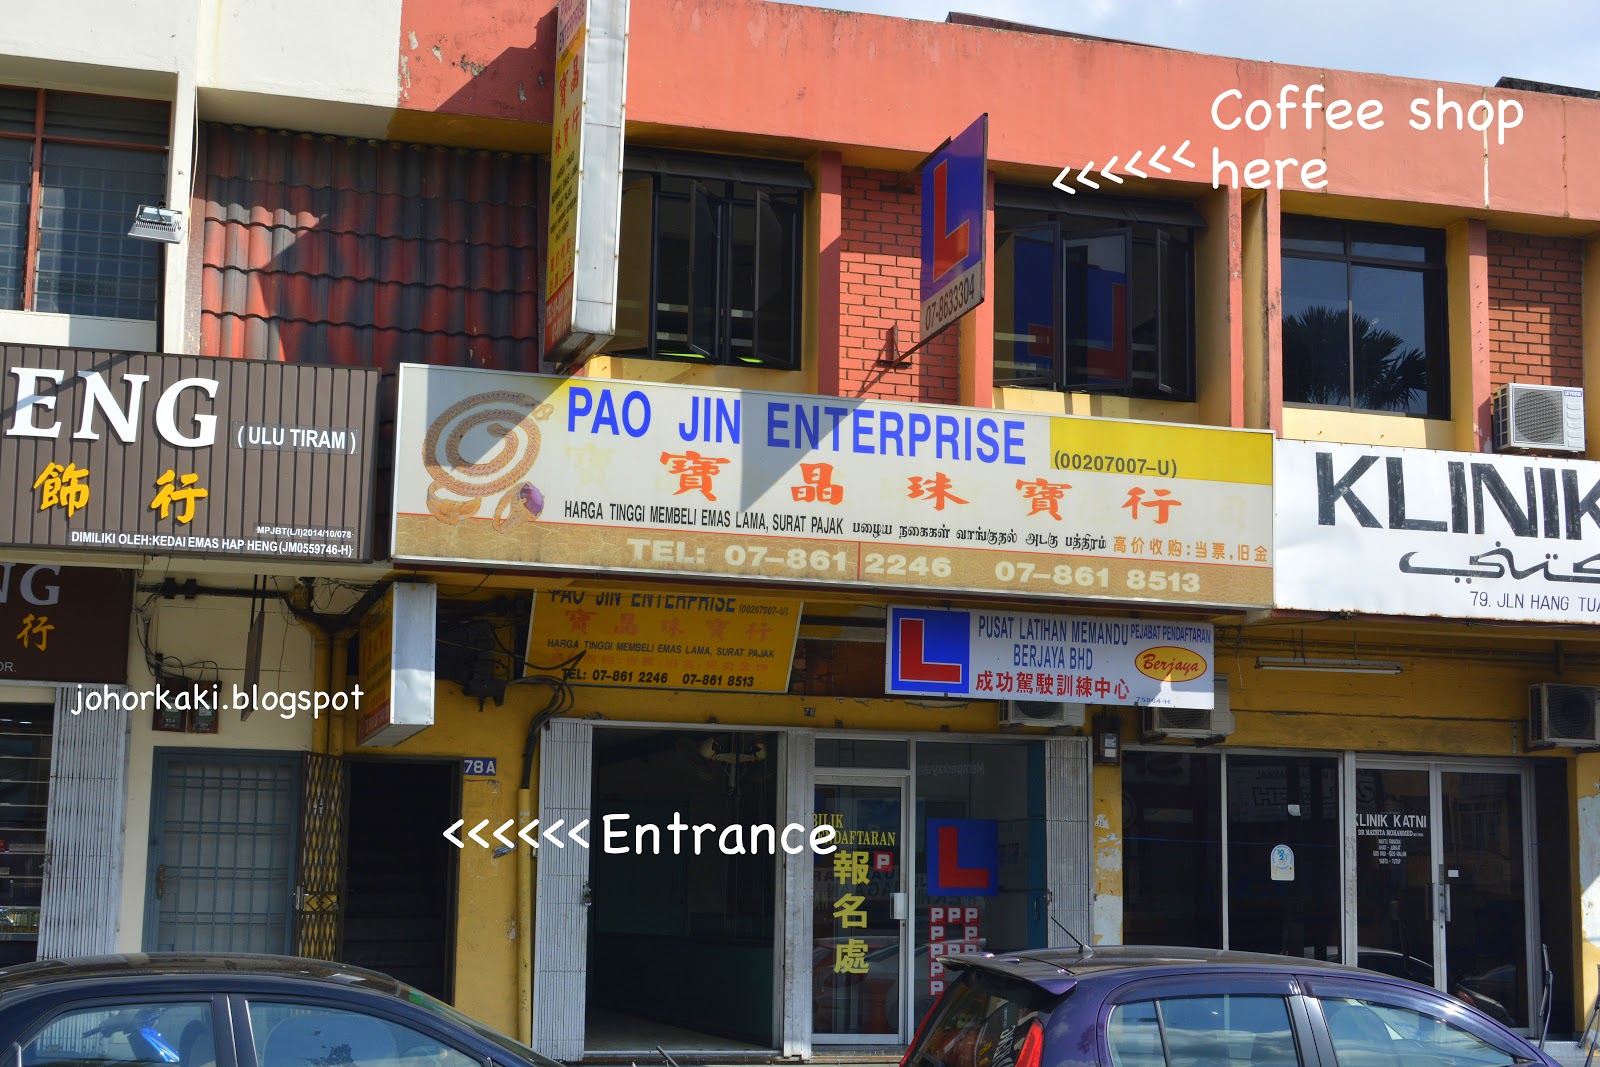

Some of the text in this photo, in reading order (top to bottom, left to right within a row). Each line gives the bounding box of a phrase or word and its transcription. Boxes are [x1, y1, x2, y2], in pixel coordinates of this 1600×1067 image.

[933, 159, 970, 283] L
[925, 273, 974, 332] 07-8633304
[6, 366, 220, 449] ENG
[567, 386, 1026, 465] PAO JIN ENTERPRISE
[1053, 450, 1178, 479] (00207007-U)
[659, 450, 1182, 525] 寶晶珠寶行
[1315, 452, 1600, 541] KLINIK
[564, 500, 843, 535] HARGA TINGGI MEMBELI EMAS LAMA, SURAT PAJAK
[852, 521, 893, 538] பழைய
[71, 531, 116, 545] DIMILIKI
[187, 536, 219, 549] EMAS
[222, 538, 245, 550] HAP
[247, 539, 277, 552] HENG
[627, 538, 1201, 593] TEL: 07-861 2246 07-861 8513
[595, 592, 621, 606] JIN
[631, 593, 737, 613] ENTERPRISE
[1470, 590, 1600, 613] 79. JLN HANG TU
[978, 615, 1129, 646] PUSAT LATIHAN MEMANDU
[1130, 623, 1212, 644] PEJABAT PENDAFTARAN
[547, 638, 775, 659] HARGA TINGGI MEMBELI EMAS LAMA, SURAT PAJAK
[899, 618, 962, 683] L
[1013, 644, 1093, 670] BERJAYA BHD
[561, 667, 757, 687] TEL: 07-861 2246 07-861 8513
[1142, 653, 1200, 678] Berjaya
[975, 670, 1130, 700] 成功駕駛訓練中心
[1394, 815, 1427, 828] KATNI
[817, 830, 897, 847] ENDAFTARAN
[877, 853, 890, 869] P
[938, 826, 989, 888] L
[833, 850, 870, 974] 報名處
[931, 908, 978, 923] P P P
[931, 926, 944, 940] P
[965, 926, 978, 940] P
[931, 980, 944, 995] P
